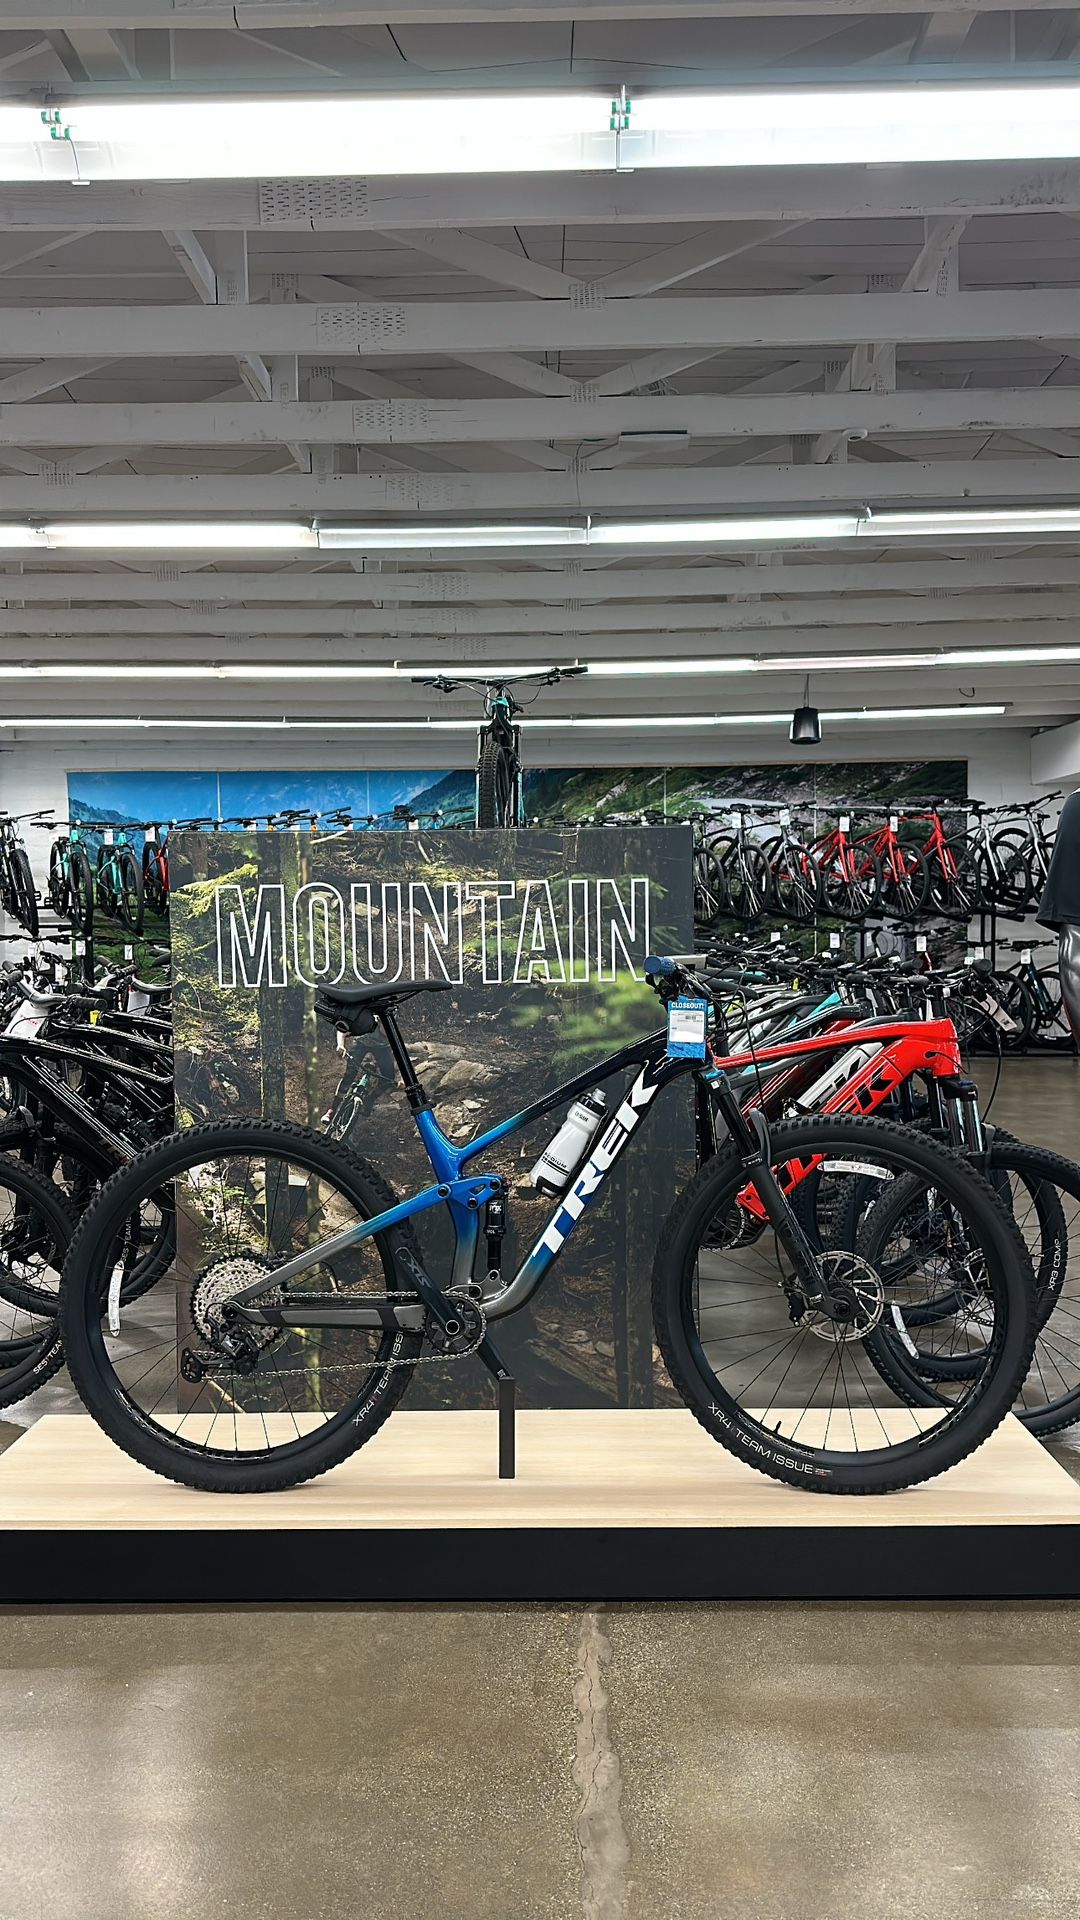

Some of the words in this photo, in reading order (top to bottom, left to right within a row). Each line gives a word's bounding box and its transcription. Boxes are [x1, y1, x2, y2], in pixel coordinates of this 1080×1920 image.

[215, 878, 650, 988] MOUNTAIN
[532, 1066, 659, 1256] TREK
[1048, 1270, 1059, 1291] XR3
[1053, 1238, 1061, 1268] COMP
[352, 1399, 375, 1427] XR4
[392, 1330, 404, 1356] ISS
[708, 1401, 732, 1429] XR4
[736, 1427, 771, 1459] TEAM
[771, 1453, 814, 1475] ISSUE
